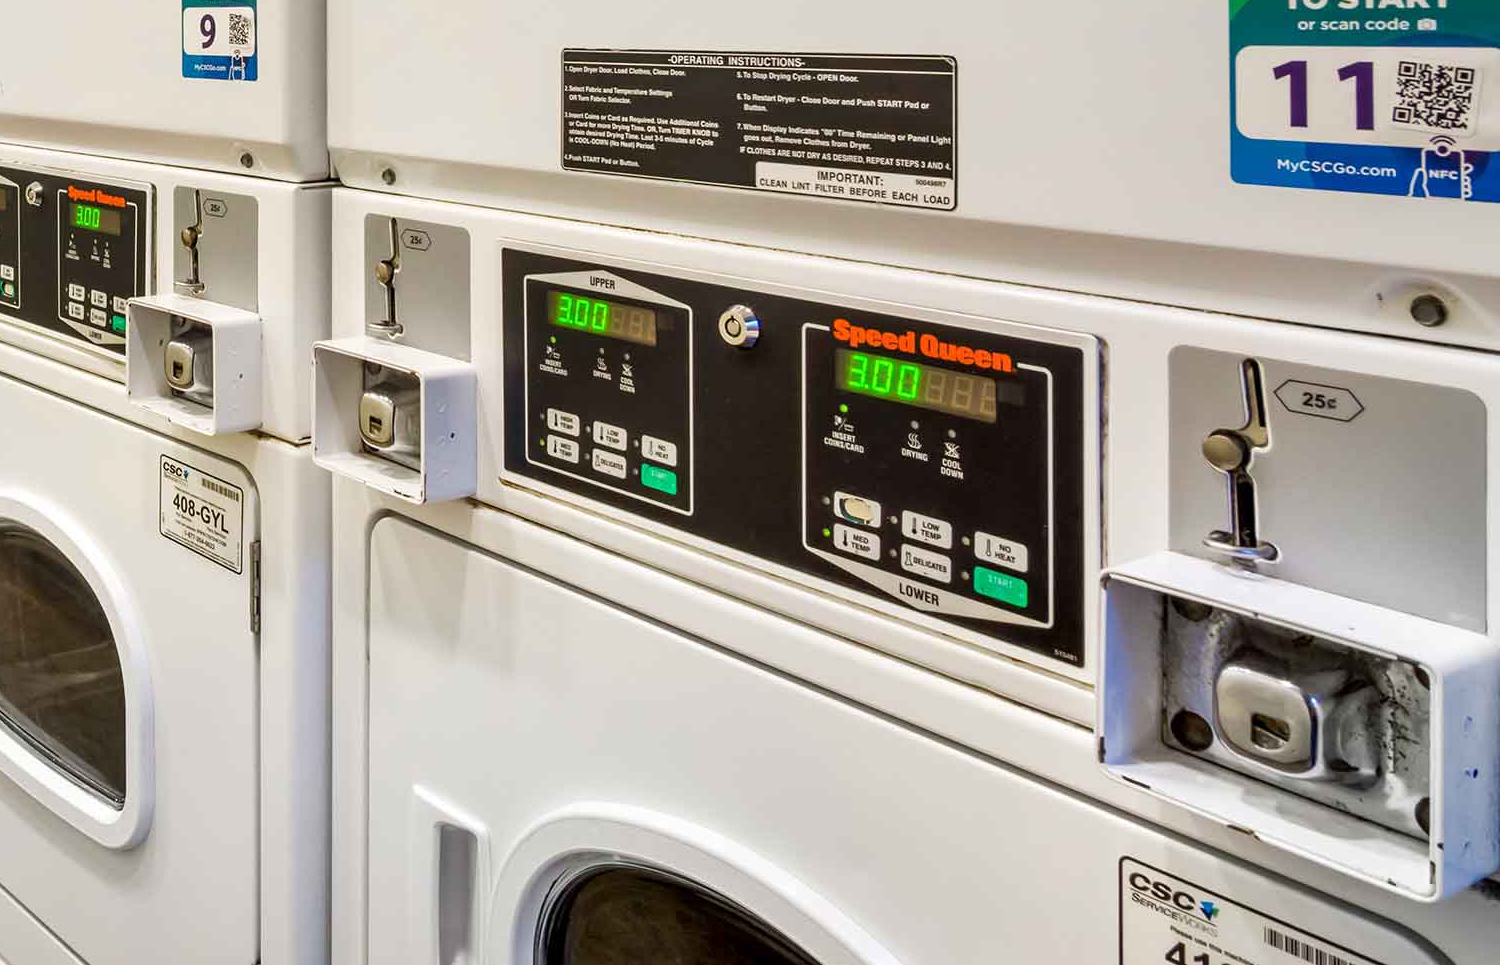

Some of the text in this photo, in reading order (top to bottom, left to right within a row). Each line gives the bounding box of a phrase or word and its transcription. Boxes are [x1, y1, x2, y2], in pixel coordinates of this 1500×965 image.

[200, 14, 216, 48] 9
[1298, 18, 1410, 30] or scan code
[752, 72, 767, 80] Stop
[768, 73, 791, 81] Drying
[792, 74, 811, 82] Cycle
[817, 74, 838, 82] OPEN
[752, 94, 776, 102] Restart
[778, 95, 796, 104] Dryer
[822, 97, 840, 105] Door
[841, 98, 855, 106] and
[856, 99, 876, 107] Push
[877, 100, 902, 108] START
[1272, 60, 1374, 130] 11
[837, 130, 855, 138] Time
[856, 131, 896, 142] Remaining
[907, 134, 929, 143] Panel
[931, 136, 951, 146] Light
[746, 147, 776, 156] CLOTHES
[777, 149, 790, 157] ARE
[792, 150, 806, 158] NOT
[866, 156, 893, 166] REPEAT
[894, 159, 919, 168] STEPS
[927, 162, 943, 170] AND
[1276, 159, 1396, 177] MyCSCGo.com
[1429, 169, 1459, 180] NFC
[817, 171, 884, 186] IMPORTANT:
[760, 178, 950, 205] CLEAN LINT FILTER BEFORE EACH LOAD
[590, 276, 616, 290] UPPER
[558, 295, 609, 332] 3.00
[833, 319, 1012, 373] Speed Queen
[848, 354, 921, 399] 3.00
[1302, 390, 1337, 410] 25¢
[832, 431, 856, 443] INSERT
[824, 437, 864, 454] COINS/CARD
[901, 448, 929, 462] DRYING
[163, 462, 182, 477] CSC
[942, 458, 962, 470] COOL
[940, 466, 964, 479] DOWN
[173, 493, 228, 534] 408-GYL
[922, 522, 940, 532] LOW
[852, 533, 868, 545] MED
[920, 529, 942, 541] TEMP
[850, 541, 871, 554] TEMP
[999, 544, 1012, 554] NO
[913, 555, 947, 573] DELICATES
[995, 551, 1016, 564] HEAT
[899, 582, 940, 606] LOWER
[1129, 872, 1195, 911] CSC
